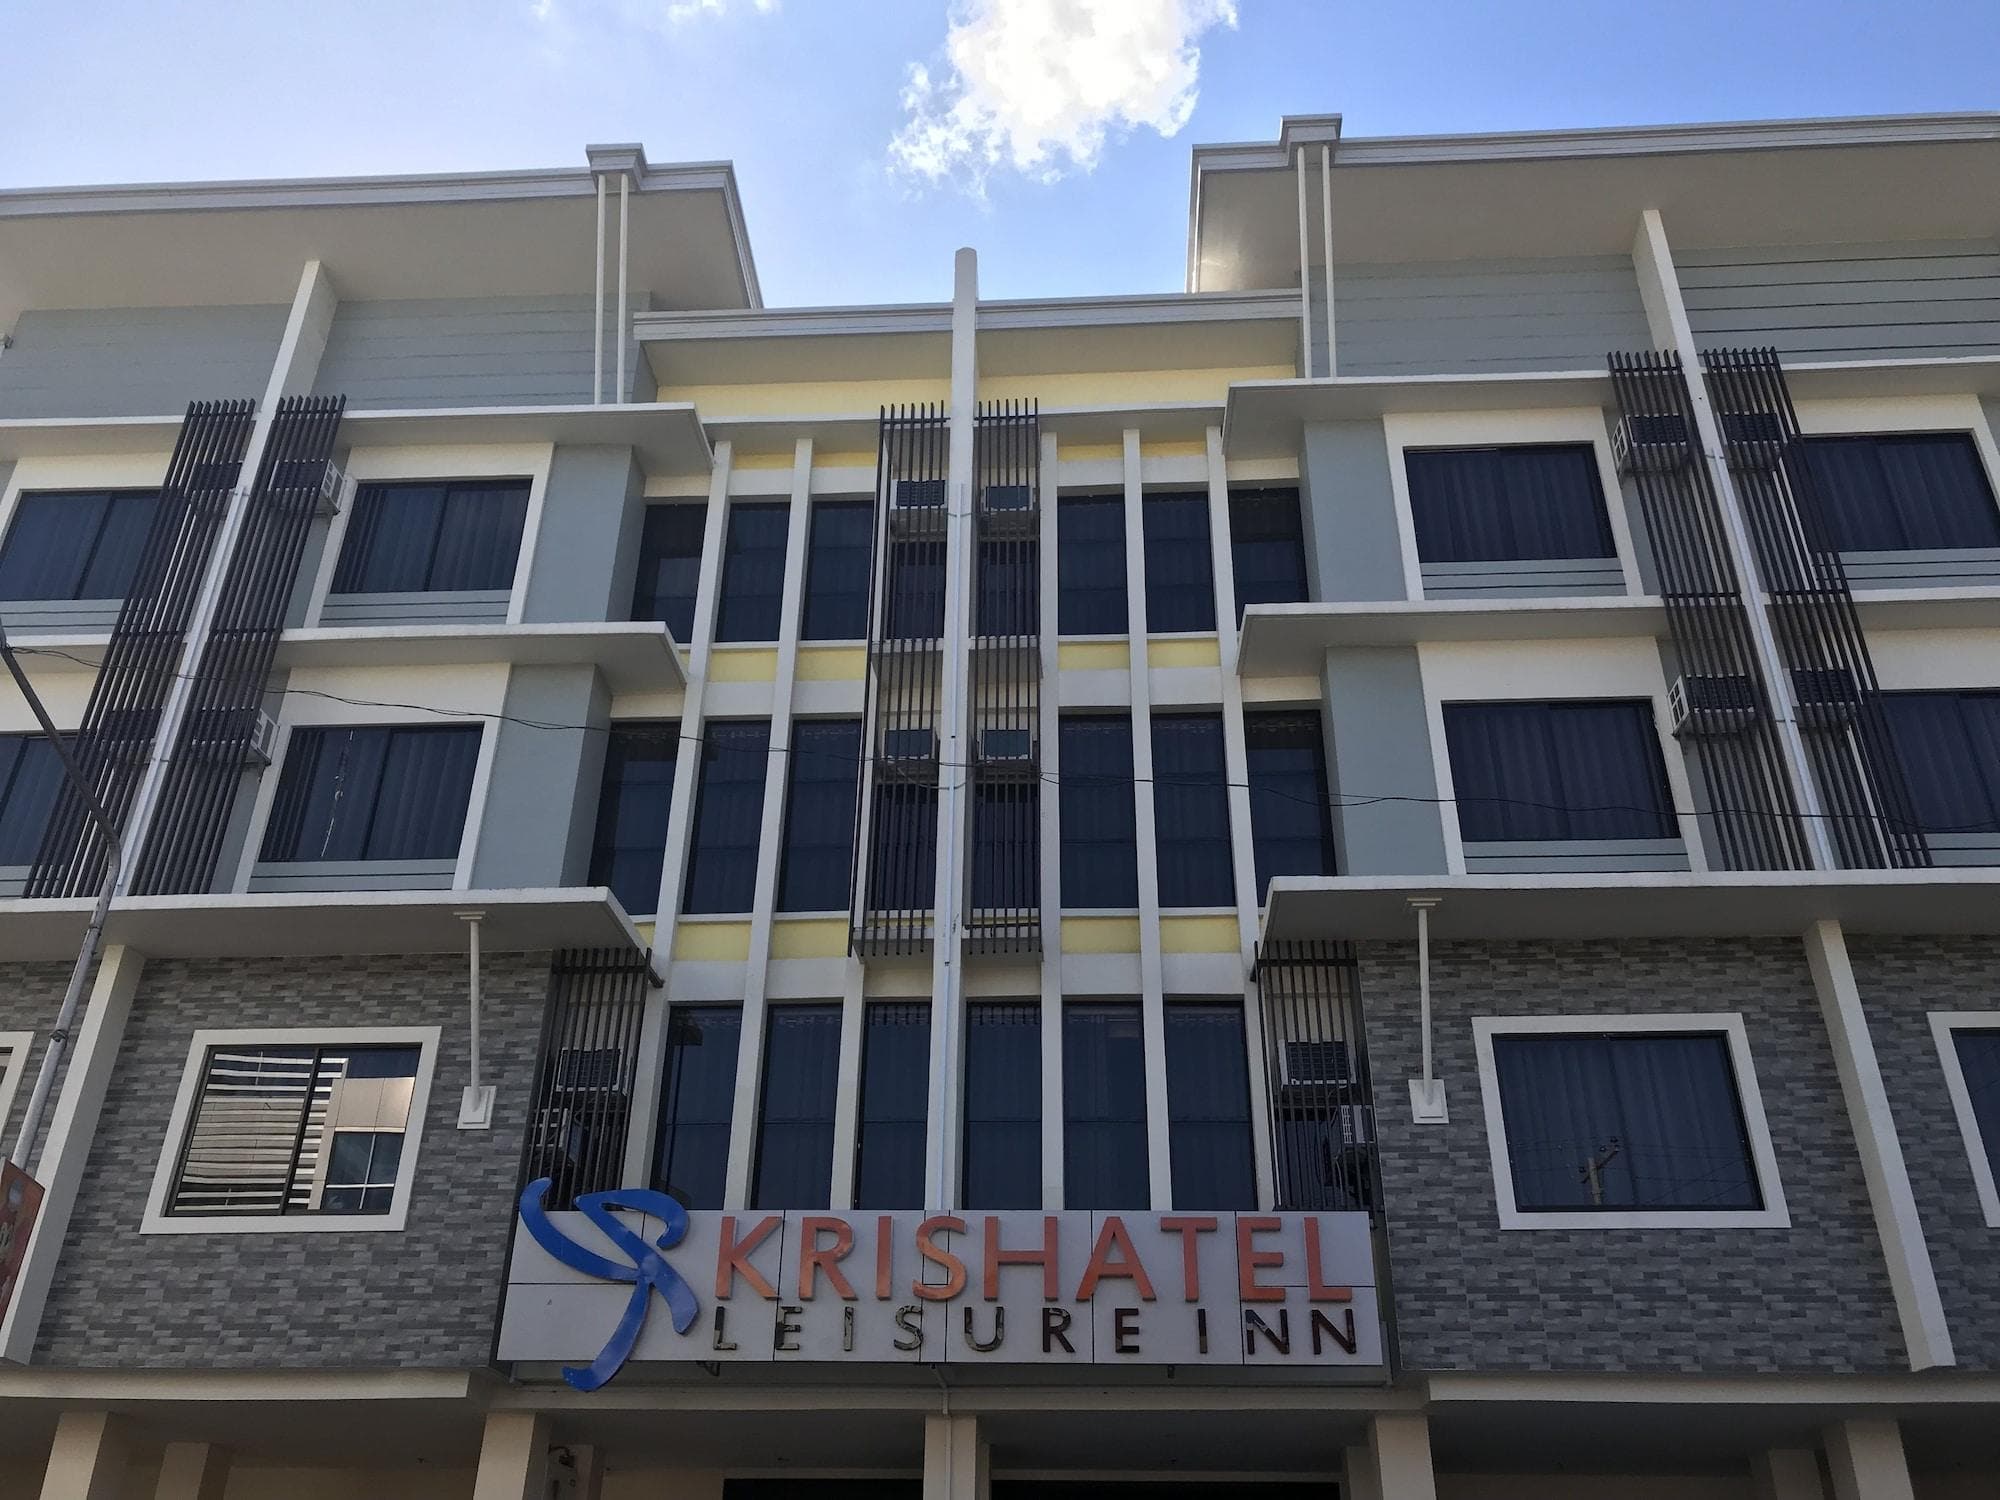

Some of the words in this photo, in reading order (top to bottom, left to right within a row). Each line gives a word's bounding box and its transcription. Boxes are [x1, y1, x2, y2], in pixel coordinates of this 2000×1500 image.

[715, 1215, 1353, 1302] KRISHATEL
[713, 1304, 1140, 1354] LEISURE
[1197, 1307, 1357, 1355] INN
